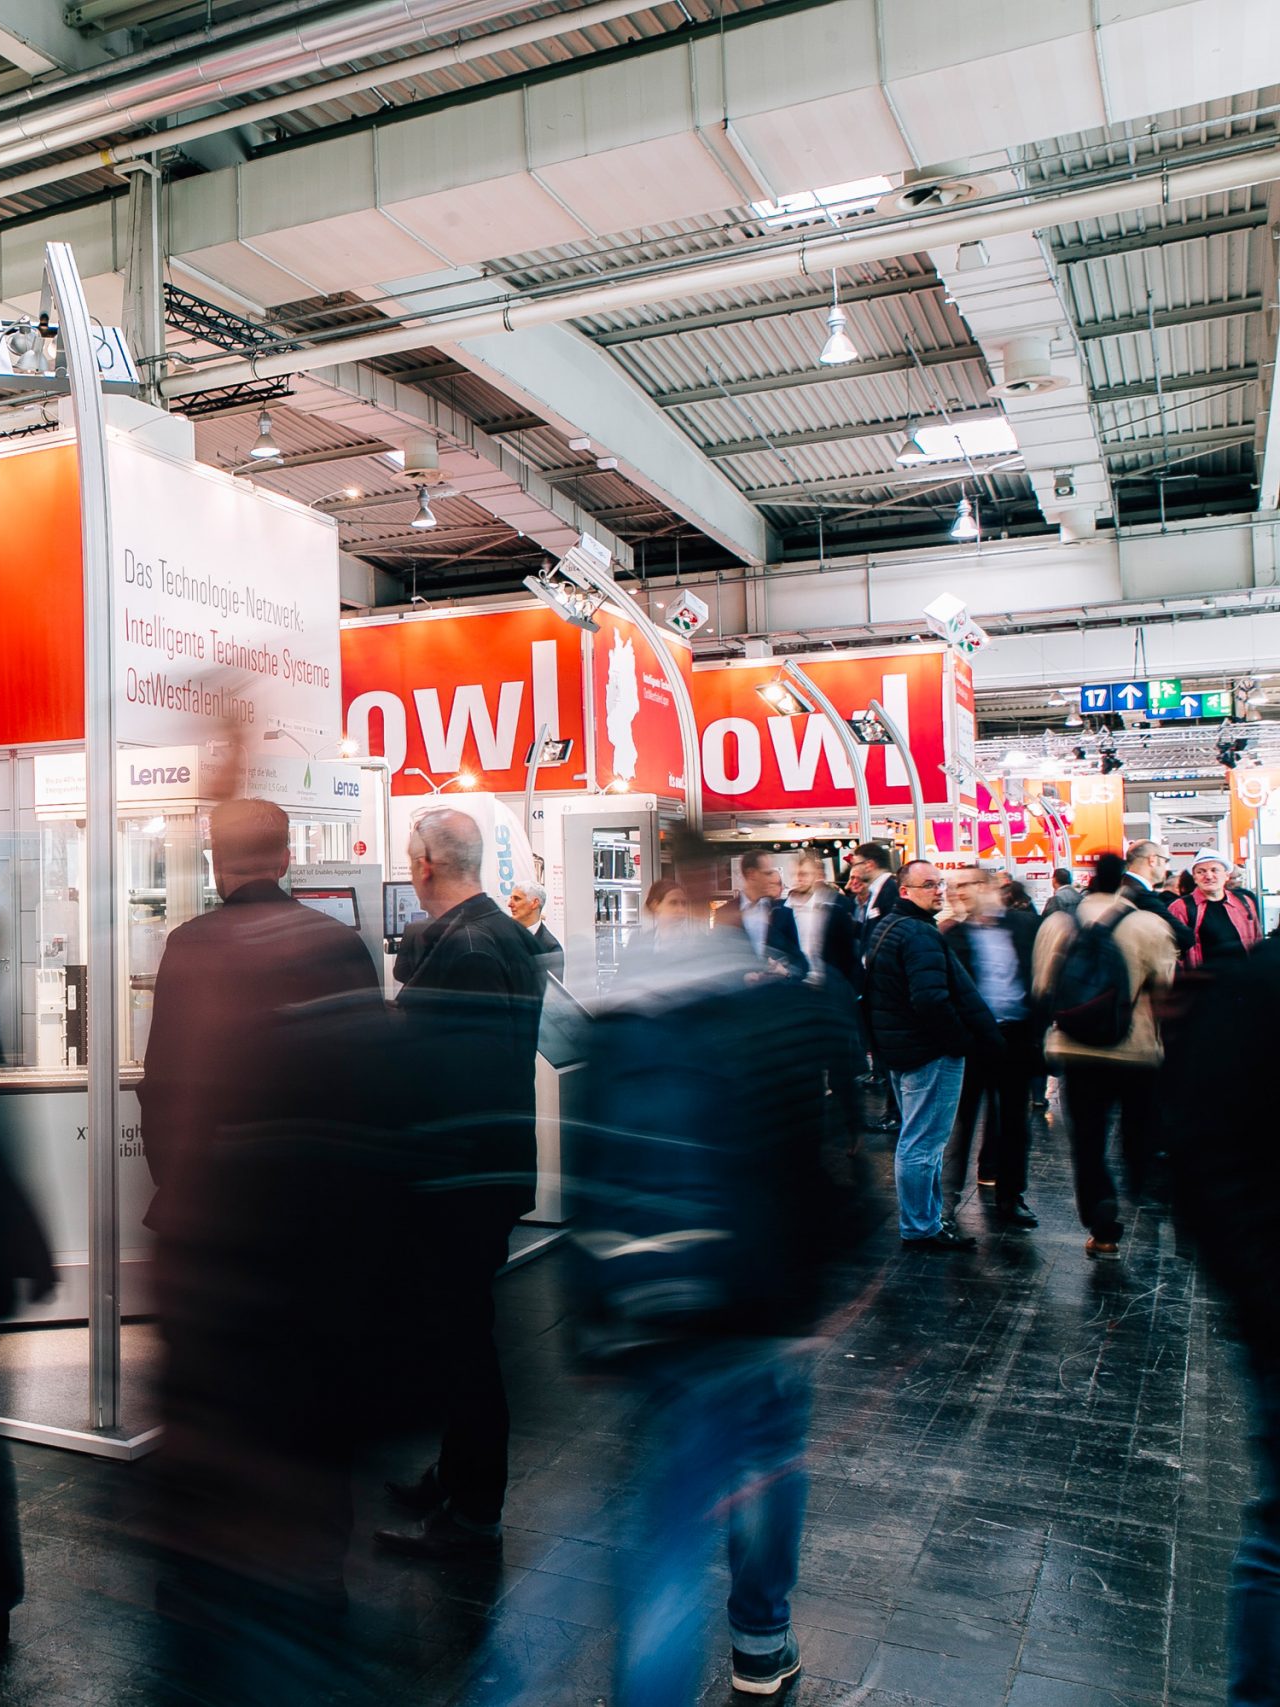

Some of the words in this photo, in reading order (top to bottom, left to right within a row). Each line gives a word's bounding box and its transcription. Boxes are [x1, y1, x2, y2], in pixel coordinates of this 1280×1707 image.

[124, 548, 153, 589] Das
[158, 558, 305, 632] Technologie-Netzwerk:
[125, 607, 205, 660] Intelligente
[210, 629, 278, 677] Technische
[283, 649, 330, 688] Systeme
[346, 639, 560, 775] owl
[702, 673, 911, 795] owl
[1085, 689, 1107, 708] 17
[130, 764, 191, 786] Lenze
[333, 776, 359, 797] Lenze
